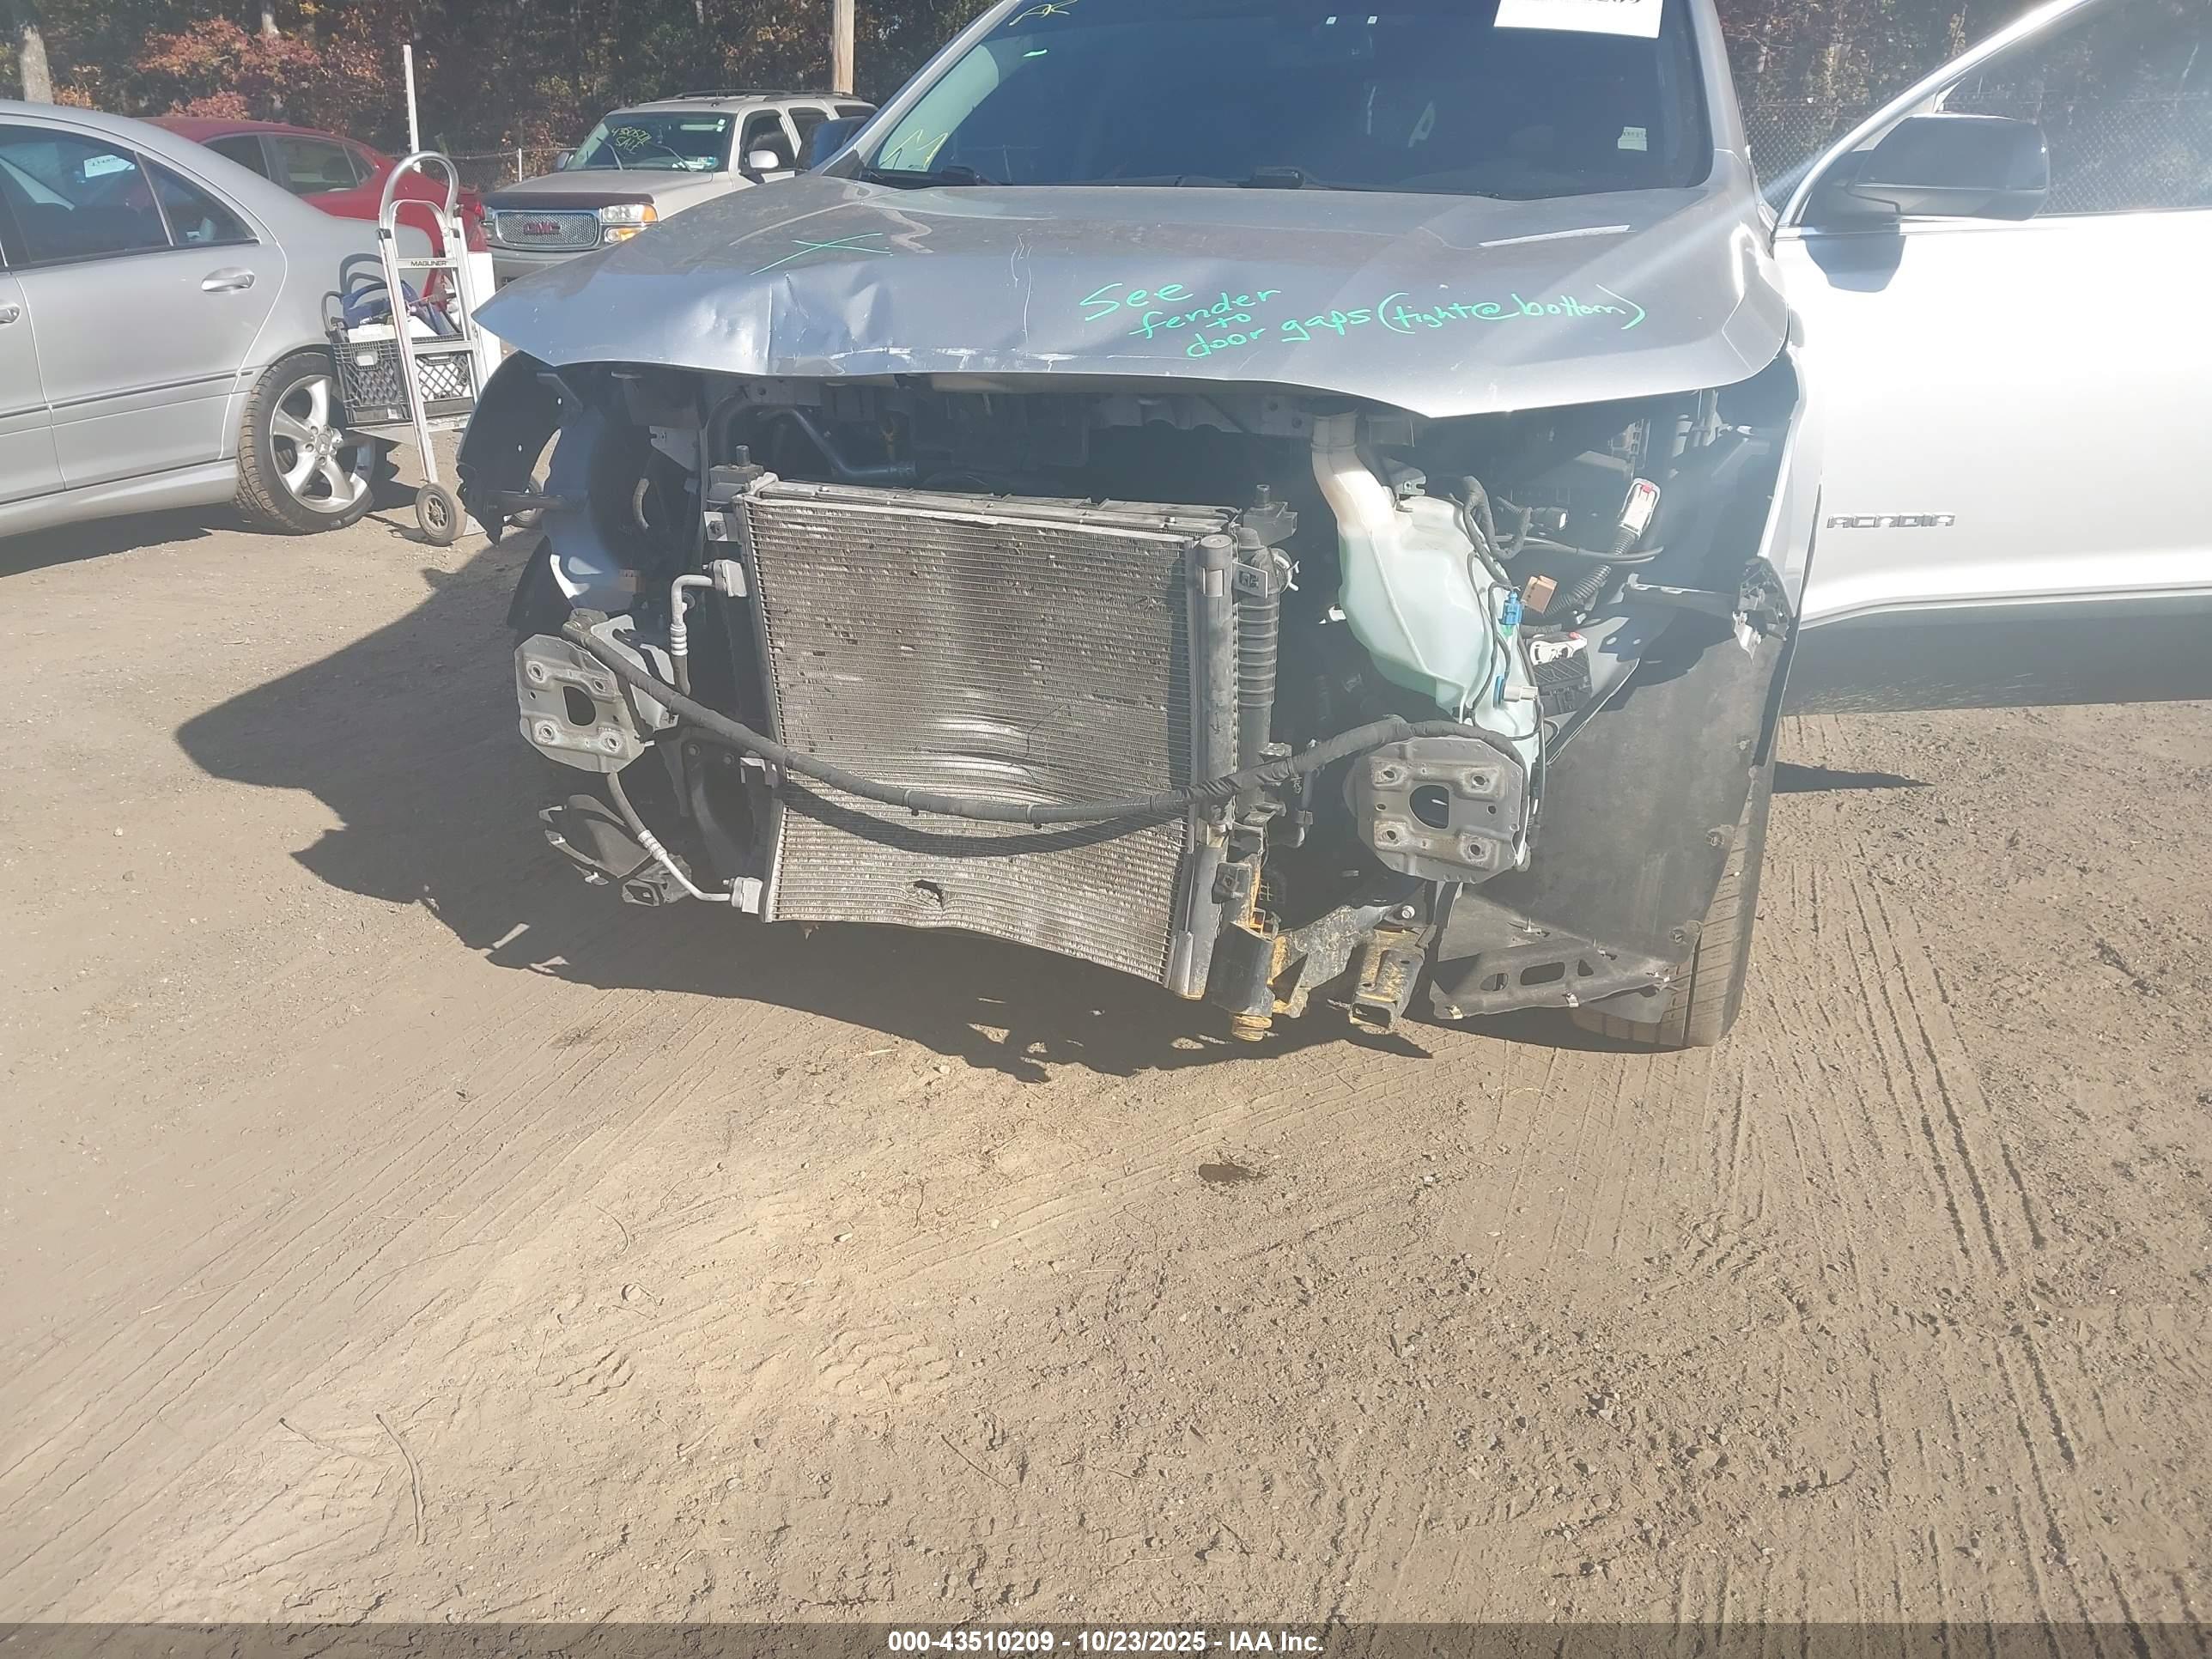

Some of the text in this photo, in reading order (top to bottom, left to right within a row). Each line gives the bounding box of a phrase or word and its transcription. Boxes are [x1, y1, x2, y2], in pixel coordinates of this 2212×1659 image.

[1079, 282, 1194, 322] See
[1128, 289, 1281, 339] fender
[1206, 313, 1252, 329] to
[1186, 327, 1266, 357] door
[1281, 309, 1372, 343] gaps
[1826, 514, 1956, 529] ACADIA
